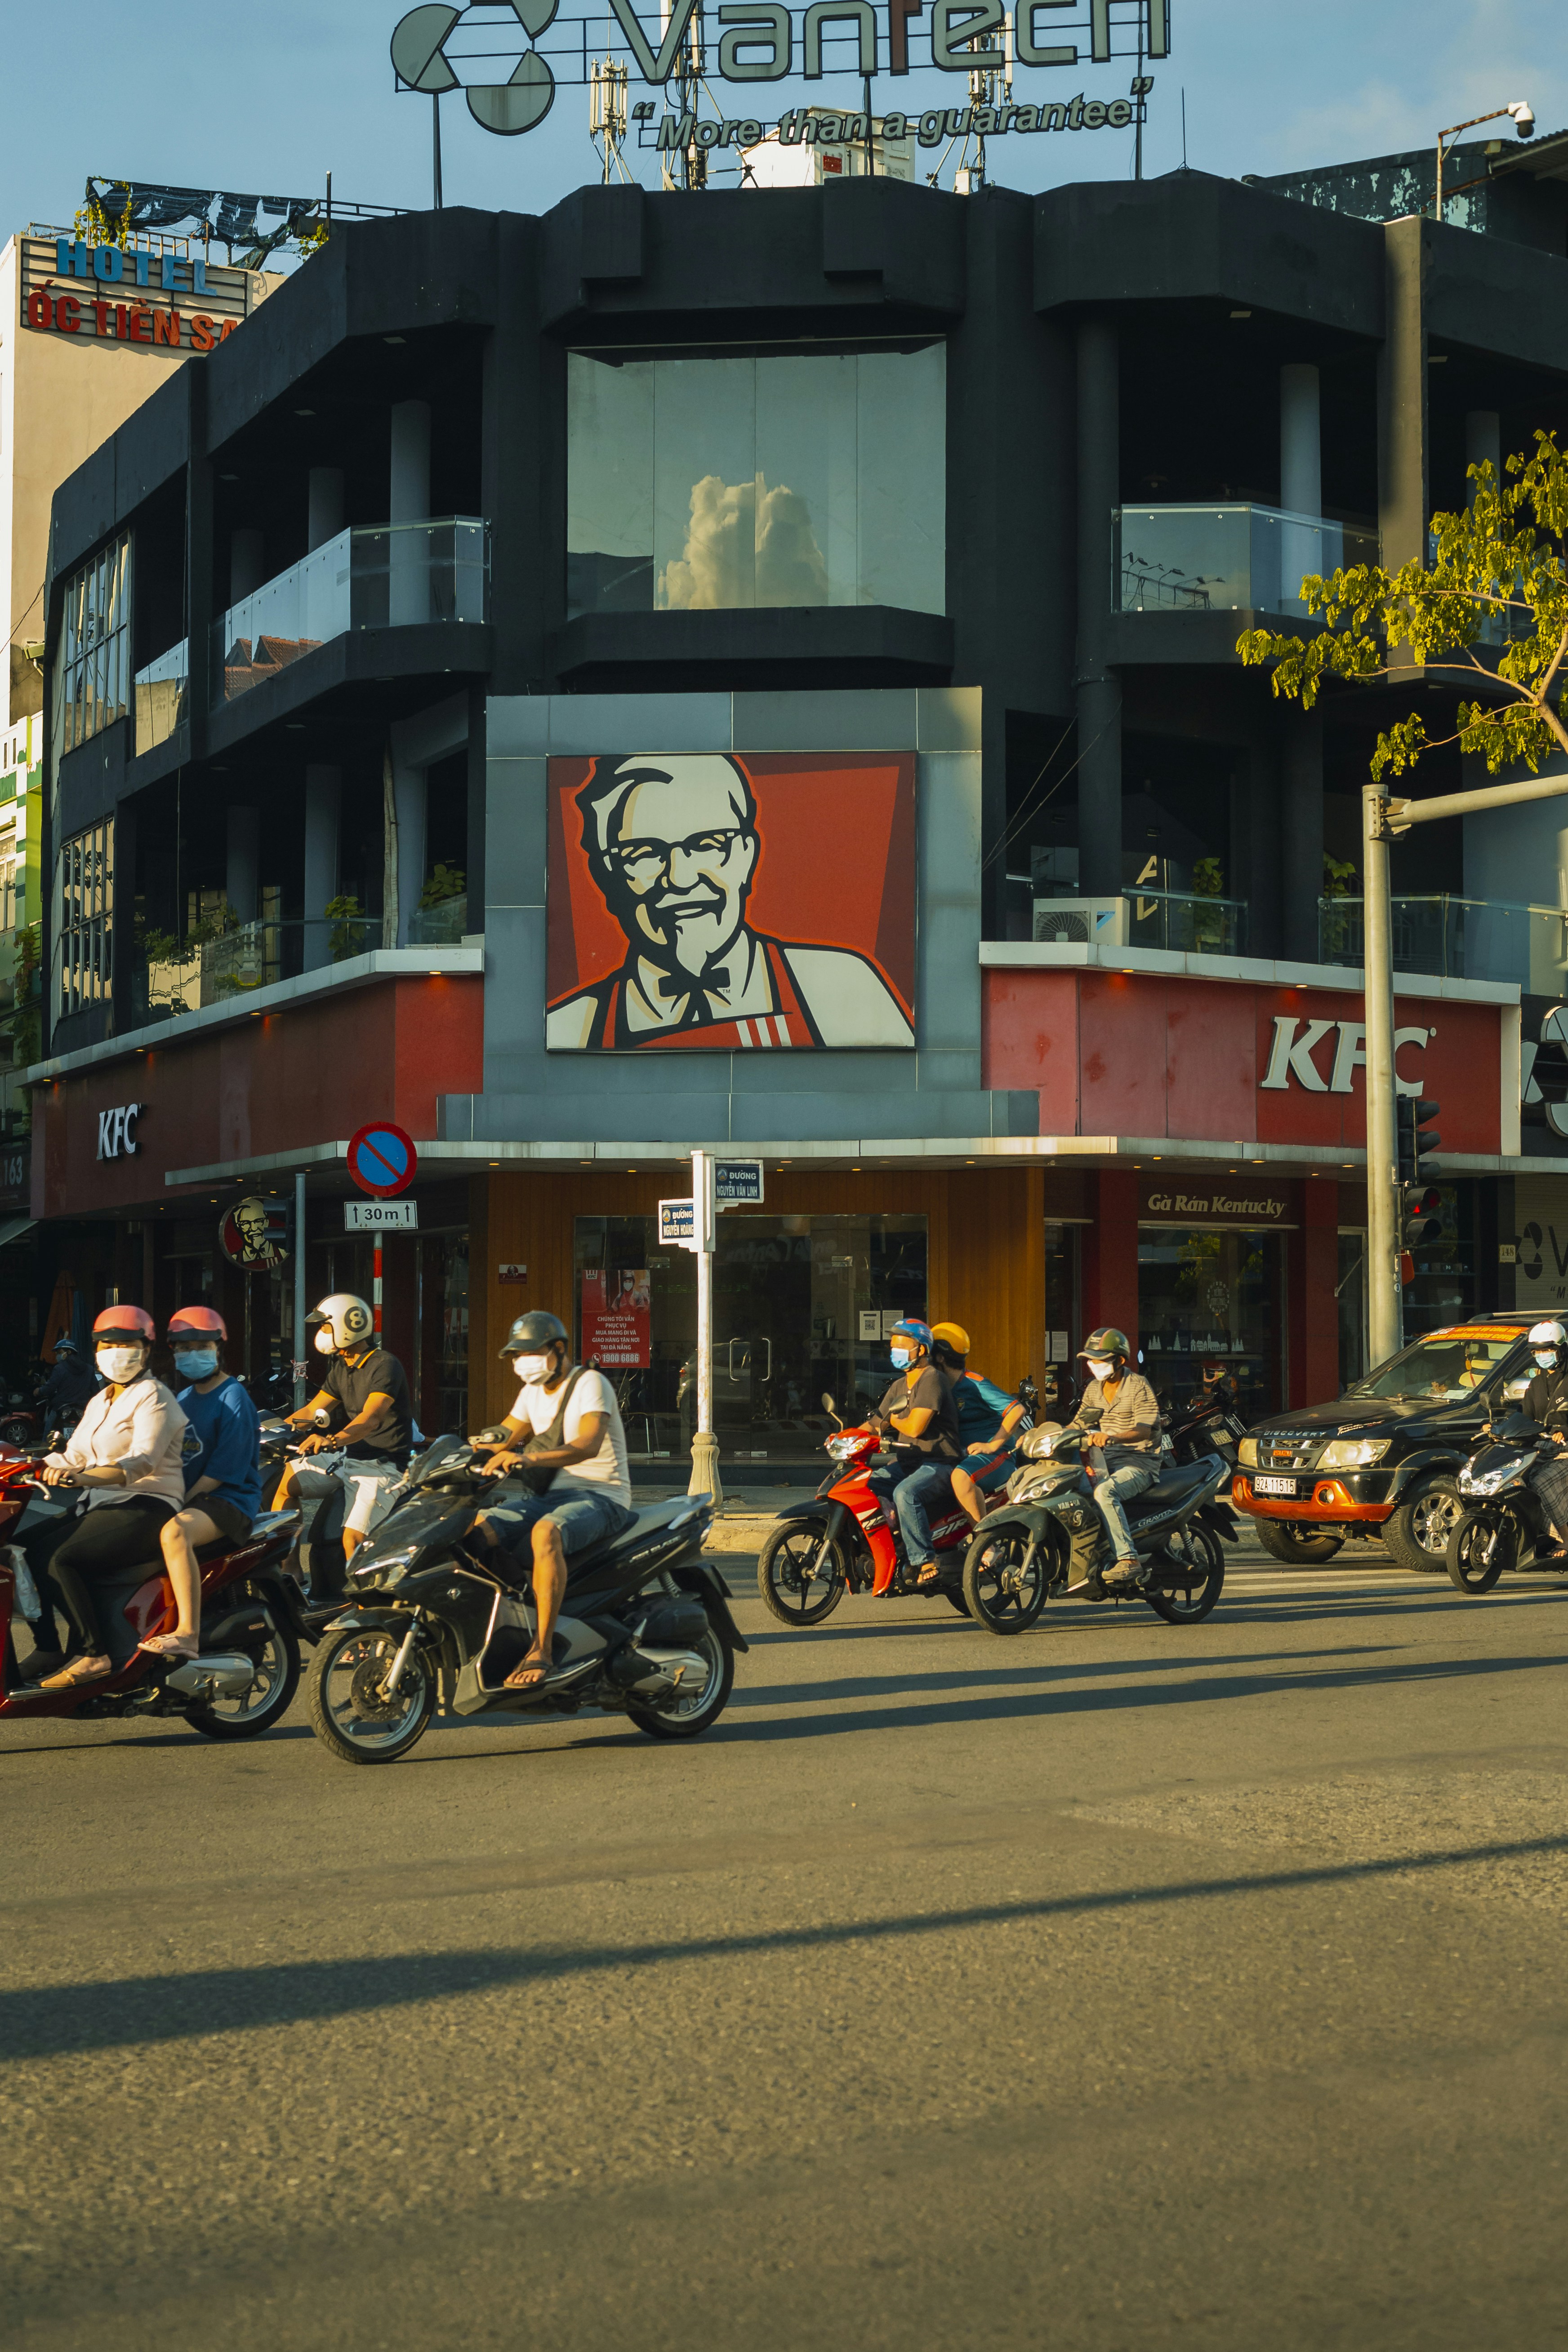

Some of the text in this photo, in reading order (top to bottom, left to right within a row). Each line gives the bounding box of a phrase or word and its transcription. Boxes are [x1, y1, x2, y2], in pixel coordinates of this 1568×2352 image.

[778, 106, 868, 146] than
[882, 111, 907, 141] a
[57, 239, 217, 297] HOTEL
[27, 280, 81, 333] ỐC
[91, 297, 180, 346] TIÊN
[96, 1103, 139, 1161] KFC
[729, 1170, 757, 1180] ĐƯỜNG
[736, 1184, 746, 1196] VĂN
[747, 1186, 757, 1197] LINH
[1148, 1194, 1285, 1218] Gà Rán Kentucky
[673, 1208, 693, 1219] ĐƯỜNG
[680, 1222, 694, 1236] HOÀNG
[1502, 1247, 1514, 1256] 148
[349, 1310, 364, 1328] 8
[602, 1353, 639, 1363] 1900 6886
[1256, 1478, 1294, 1492] 92A-115.15
[1504, 1491, 1521, 1499] HONDA
[1057, 1499, 1081, 1510] YAMHA
[1138, 1509, 1176, 1527] GRAVITA
